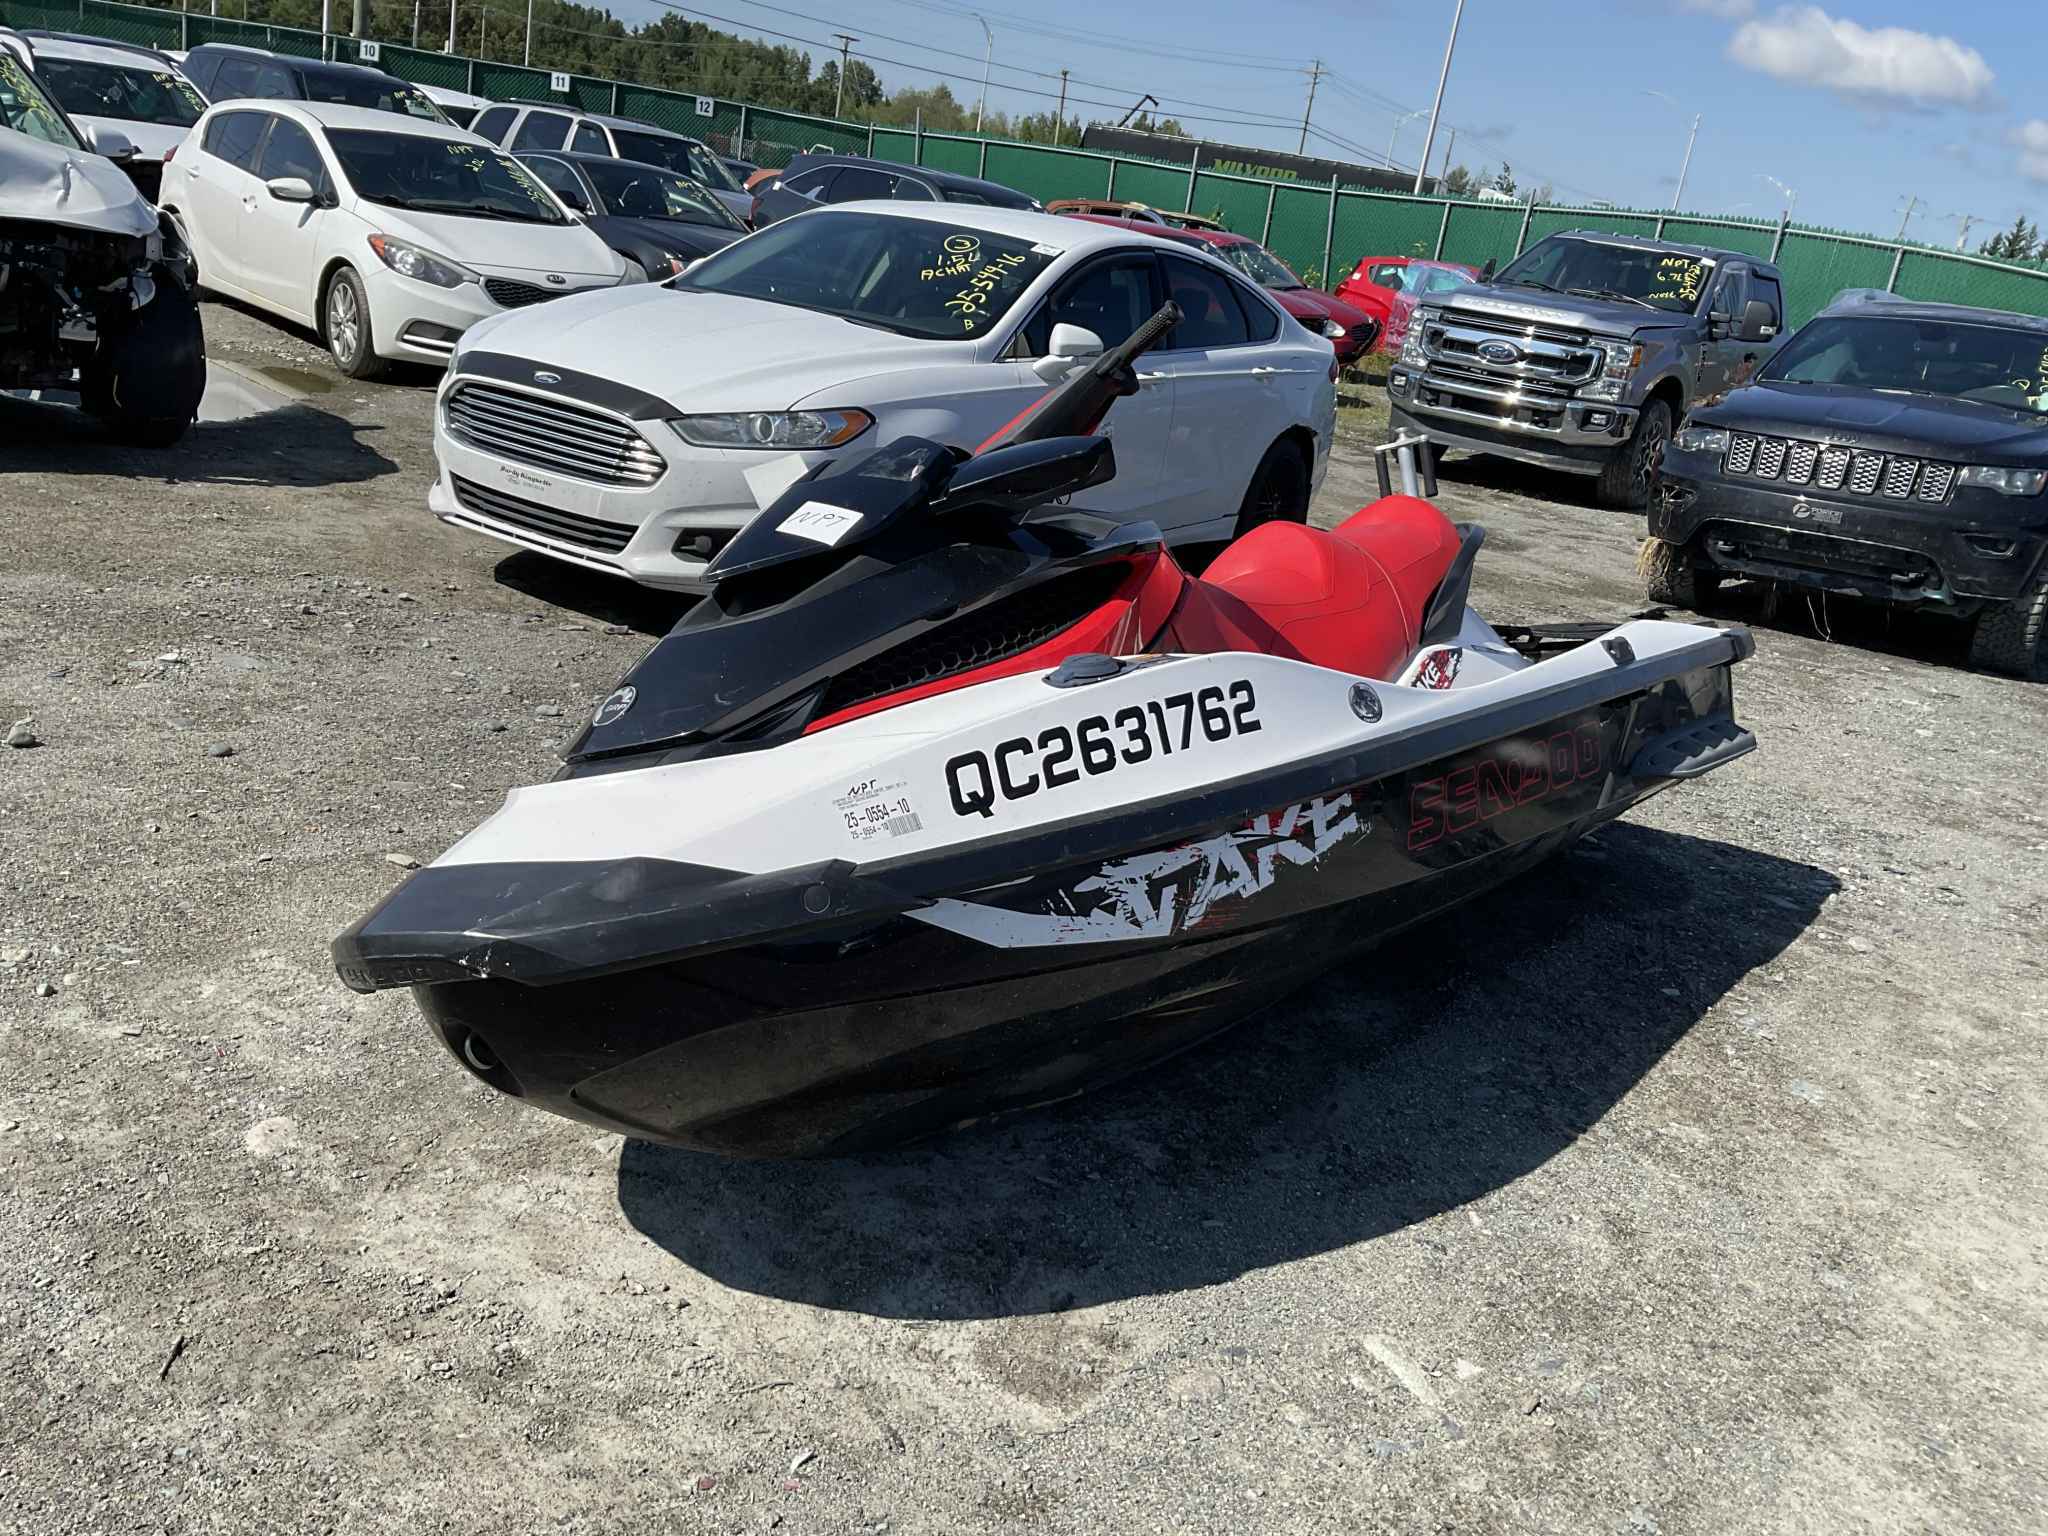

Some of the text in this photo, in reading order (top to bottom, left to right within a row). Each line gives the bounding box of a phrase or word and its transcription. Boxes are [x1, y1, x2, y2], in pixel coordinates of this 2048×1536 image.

[363, 44, 376, 57] 10
[553, 75, 566, 88] 11
[699, 100, 711, 113] 12
[1660, 257, 1691, 270] NPT
[920, 262, 972, 281] ACHAT
[786, 511, 851, 528] NPT
[944, 679, 1263, 819] QC2631762
[844, 797, 911, 829] 25-0554-10
